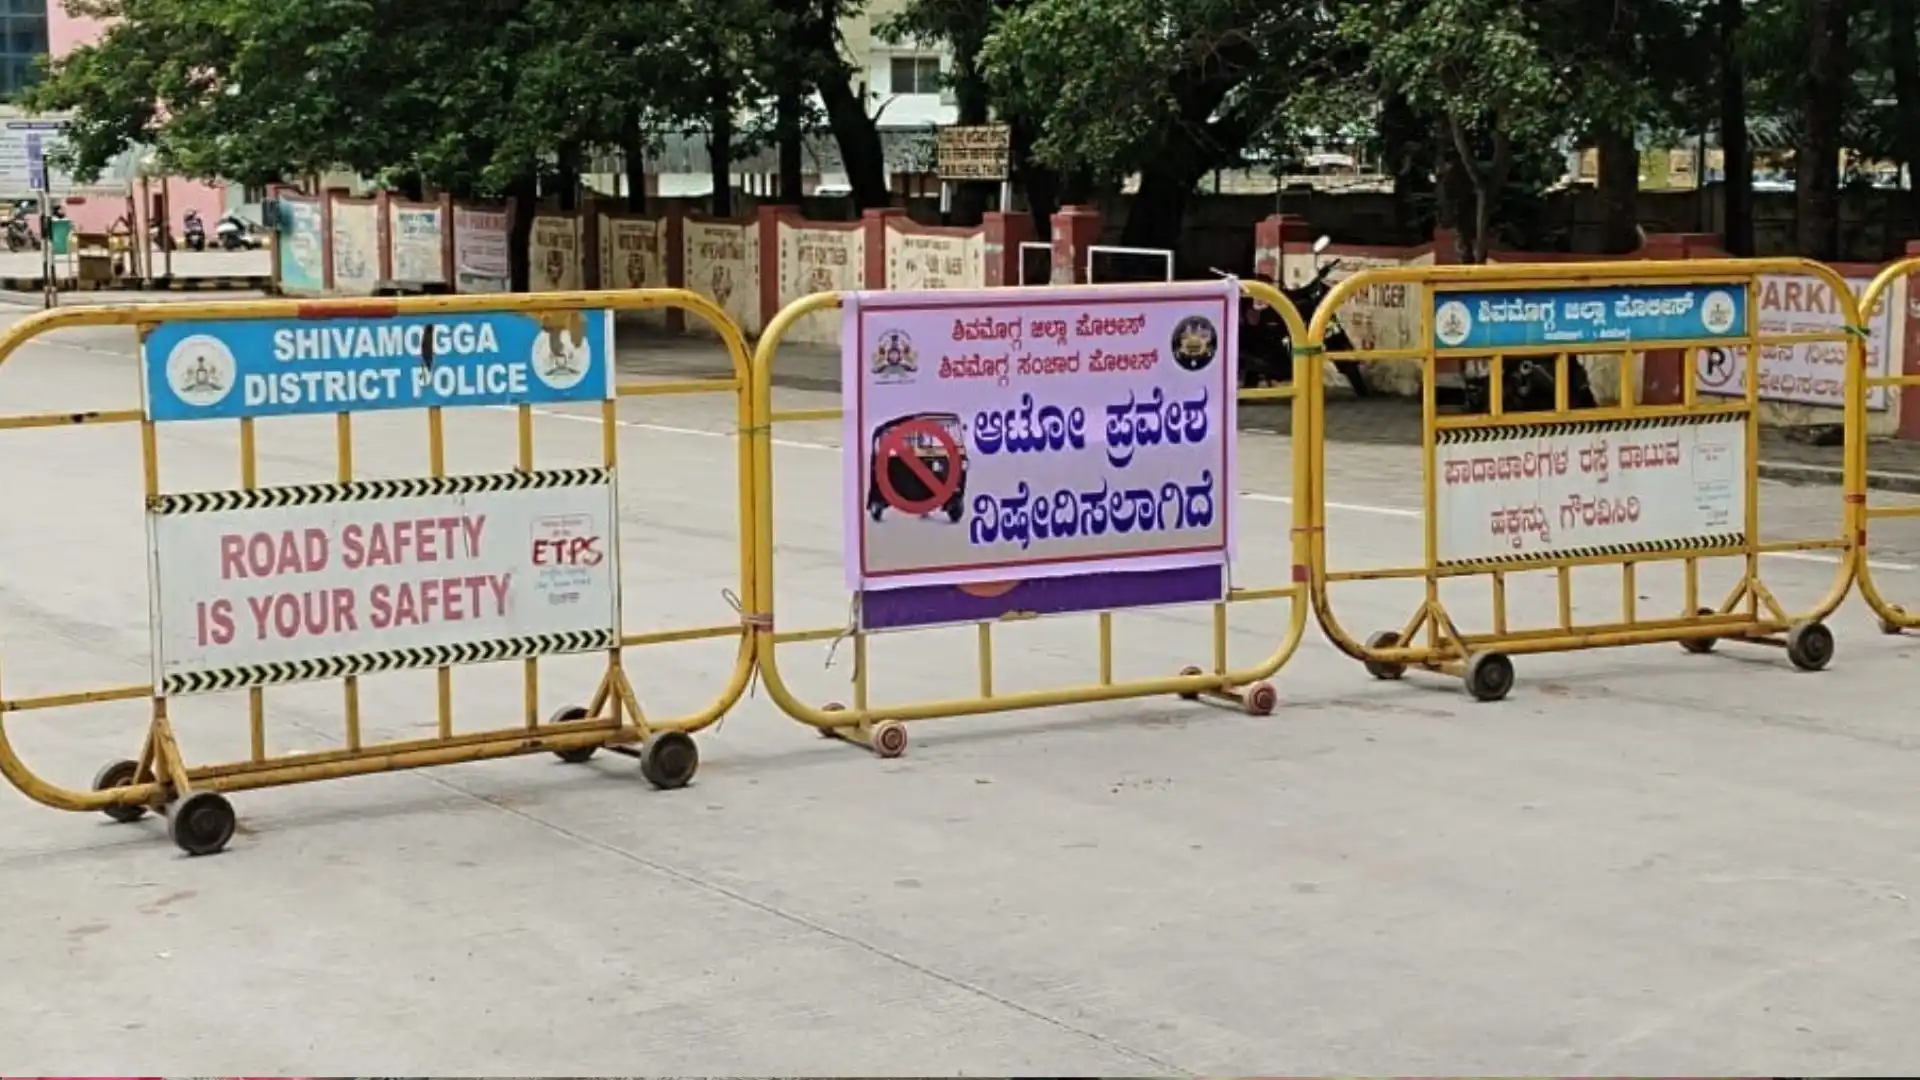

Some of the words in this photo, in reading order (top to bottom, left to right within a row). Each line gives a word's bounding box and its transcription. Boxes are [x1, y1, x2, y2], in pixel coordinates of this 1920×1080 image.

[952, 317, 1022, 350] ಶಿವಮೊಗ್ಗ
[1031, 319, 1067, 346] ಜಿಲ್ಲಾ
[1479, 297, 1555, 331] ಶಿವಮೊಗ್ಗ
[244, 370, 402, 406] DISTRICT
[411, 363, 529, 398] POLICE
[939, 352, 1009, 386] ಶಿವಮೊಗ್ಗ
[1017, 351, 1080, 375] ಸಂಚಾರ
[974, 392, 1085, 454] ಆಟೋ
[1106, 386, 1208, 468] ಪ್ರವೇಶ
[1579, 439, 1609, 483] ರಸ್ತೆ
[221, 527, 329, 580] ROAD
[342, 515, 486, 569] SAFETY
[532, 537, 603, 566] ETPS
[196, 599, 235, 646] IS
[248, 588, 357, 640] YOUR
[370, 573, 512, 629] SAFETY
